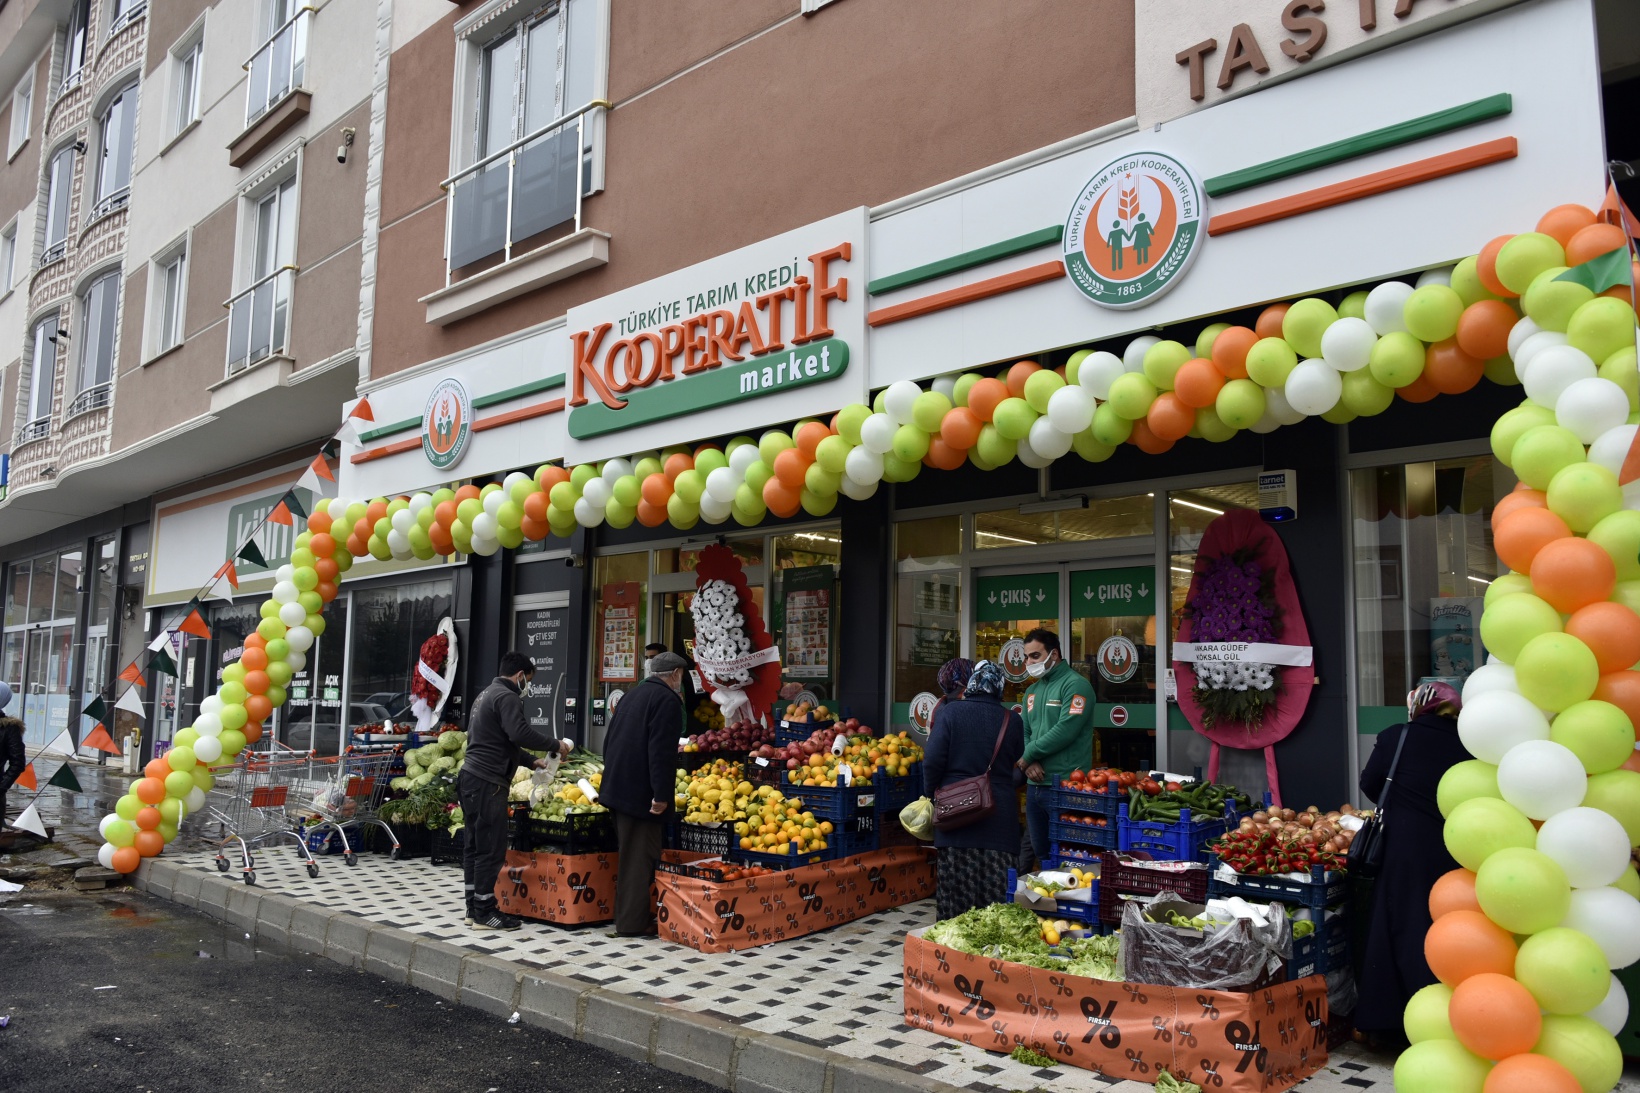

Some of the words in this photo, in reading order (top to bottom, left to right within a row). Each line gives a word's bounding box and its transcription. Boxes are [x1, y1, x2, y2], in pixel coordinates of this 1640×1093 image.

[1070, 203, 1087, 249] TÜRKİYE
[1083, 174, 1109, 202] TARIM
[1110, 159, 1140, 177] KREDİ
[1141, 159, 1194, 219] KOOPERATİFLERİ
[619, 300, 681, 336] TÜRKİYE
[686, 282, 738, 315] TARIM
[745, 256, 798, 297] KREDİ
[1117, 282, 1143, 297] 1863
[569, 241, 852, 411] KOOPERATİF
[740, 345, 830, 394] market
[1260, 475, 1285, 485] tarnet
[1000, 589, 1031, 608] ÇIKIŞ
[1098, 583, 1133, 603] ÇIKIŞ
[537, 611, 551, 619] KADIN
[1432, 604, 1472, 621] familia
[1194, 644, 1219, 652] ANKARA
[1220, 643, 1249, 652] GÜDEF
[1223, 652, 1241, 661] GÜL
[963, 991, 983, 1001] FIRSAT
[1087, 1016, 1111, 1026] FIRSAT
[1235, 1042, 1261, 1051] FIRSAT
